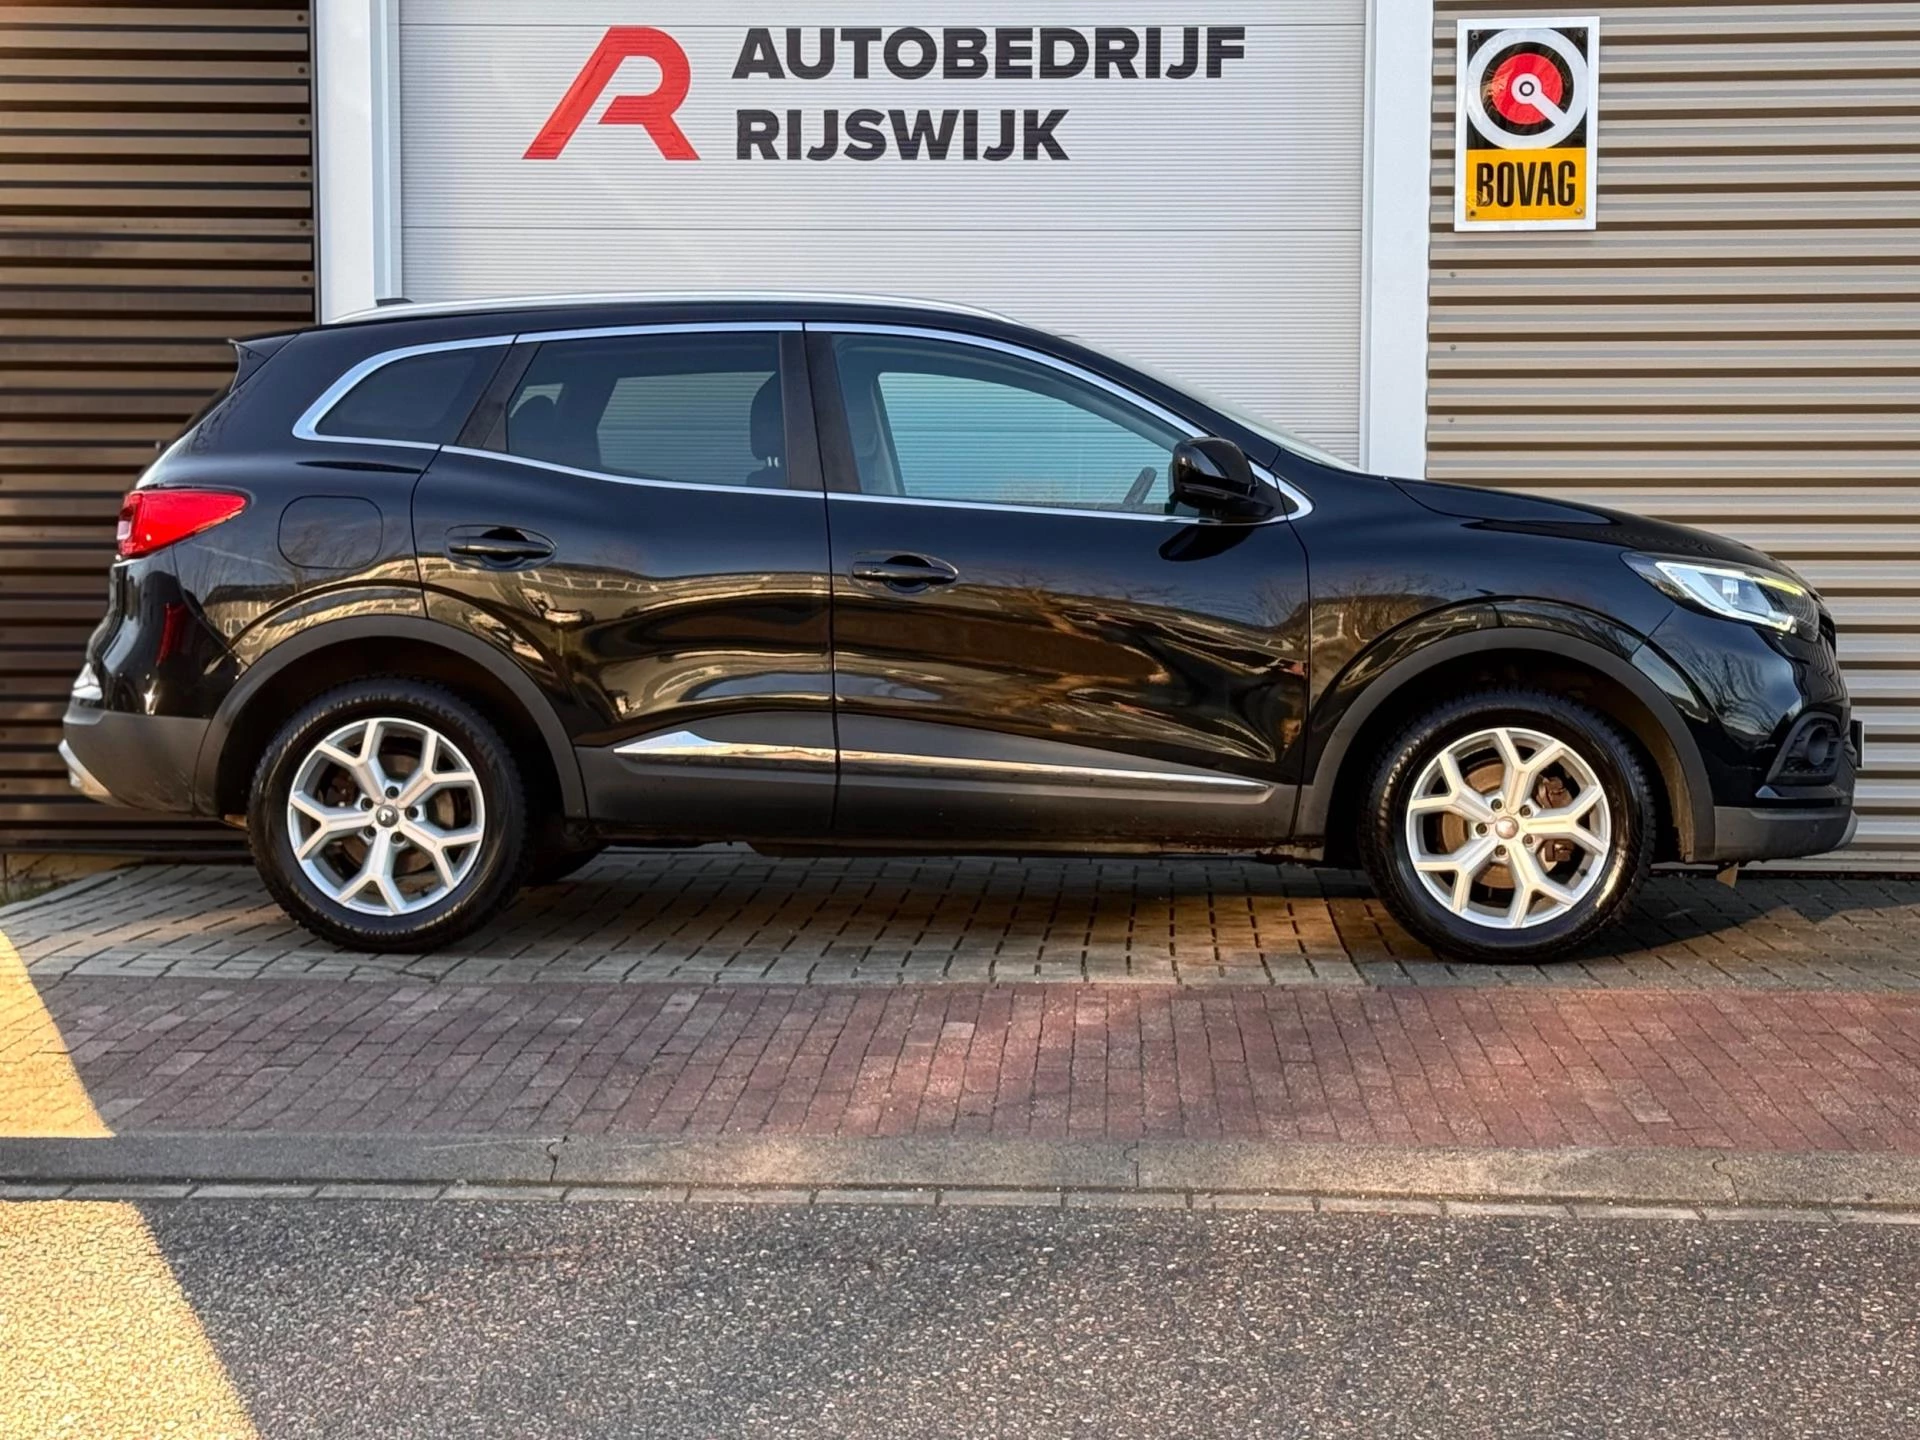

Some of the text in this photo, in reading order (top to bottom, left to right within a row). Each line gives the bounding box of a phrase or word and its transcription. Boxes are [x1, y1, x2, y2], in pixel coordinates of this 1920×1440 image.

[732, 27, 1246, 79] AUTOBEDRIJF
[736, 109, 1069, 161] RIJSWIJK
[1476, 160, 1576, 207] BOVAG
